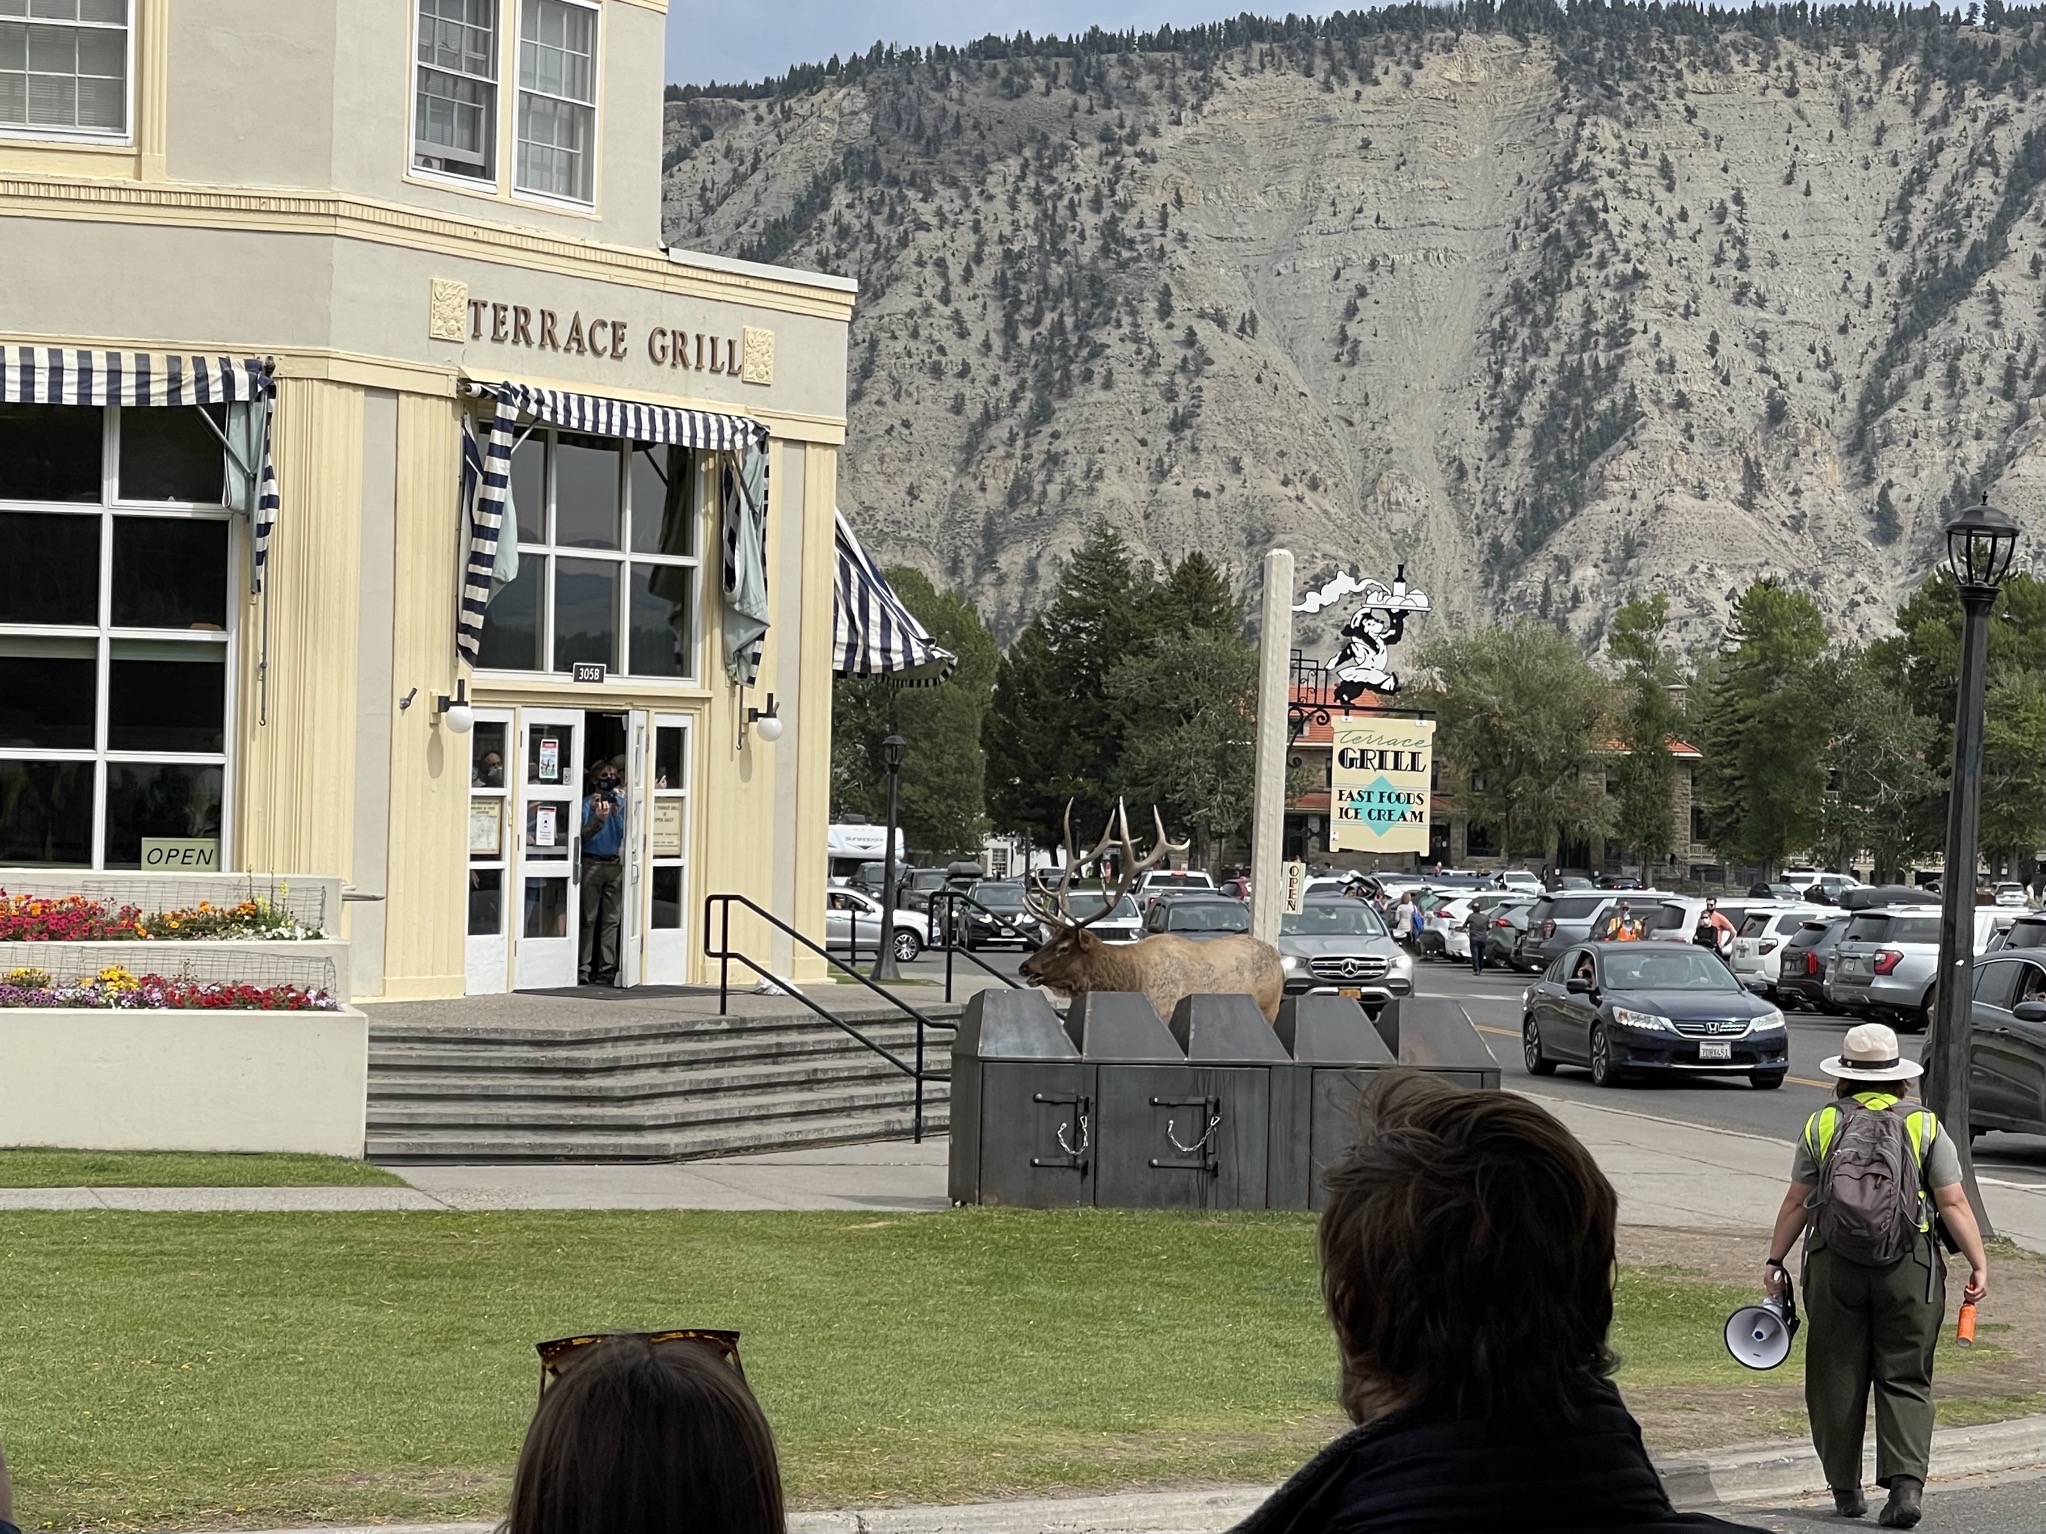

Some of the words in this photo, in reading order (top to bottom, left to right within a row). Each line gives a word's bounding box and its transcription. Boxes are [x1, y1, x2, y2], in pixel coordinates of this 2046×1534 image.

[468, 299, 628, 359] TERRACE
[648, 326, 742, 376] GRILL
[1334, 730, 1431, 748] Terrace
[1338, 747, 1427, 772] GRILL
[1337, 789, 1375, 804] FAST
[1378, 791, 1425, 806] FOODS
[1338, 807, 1363, 820] ICE
[1367, 808, 1425, 823] CREAM
[147, 848, 213, 865] OPEN
[1286, 865, 1300, 911] OPEN
